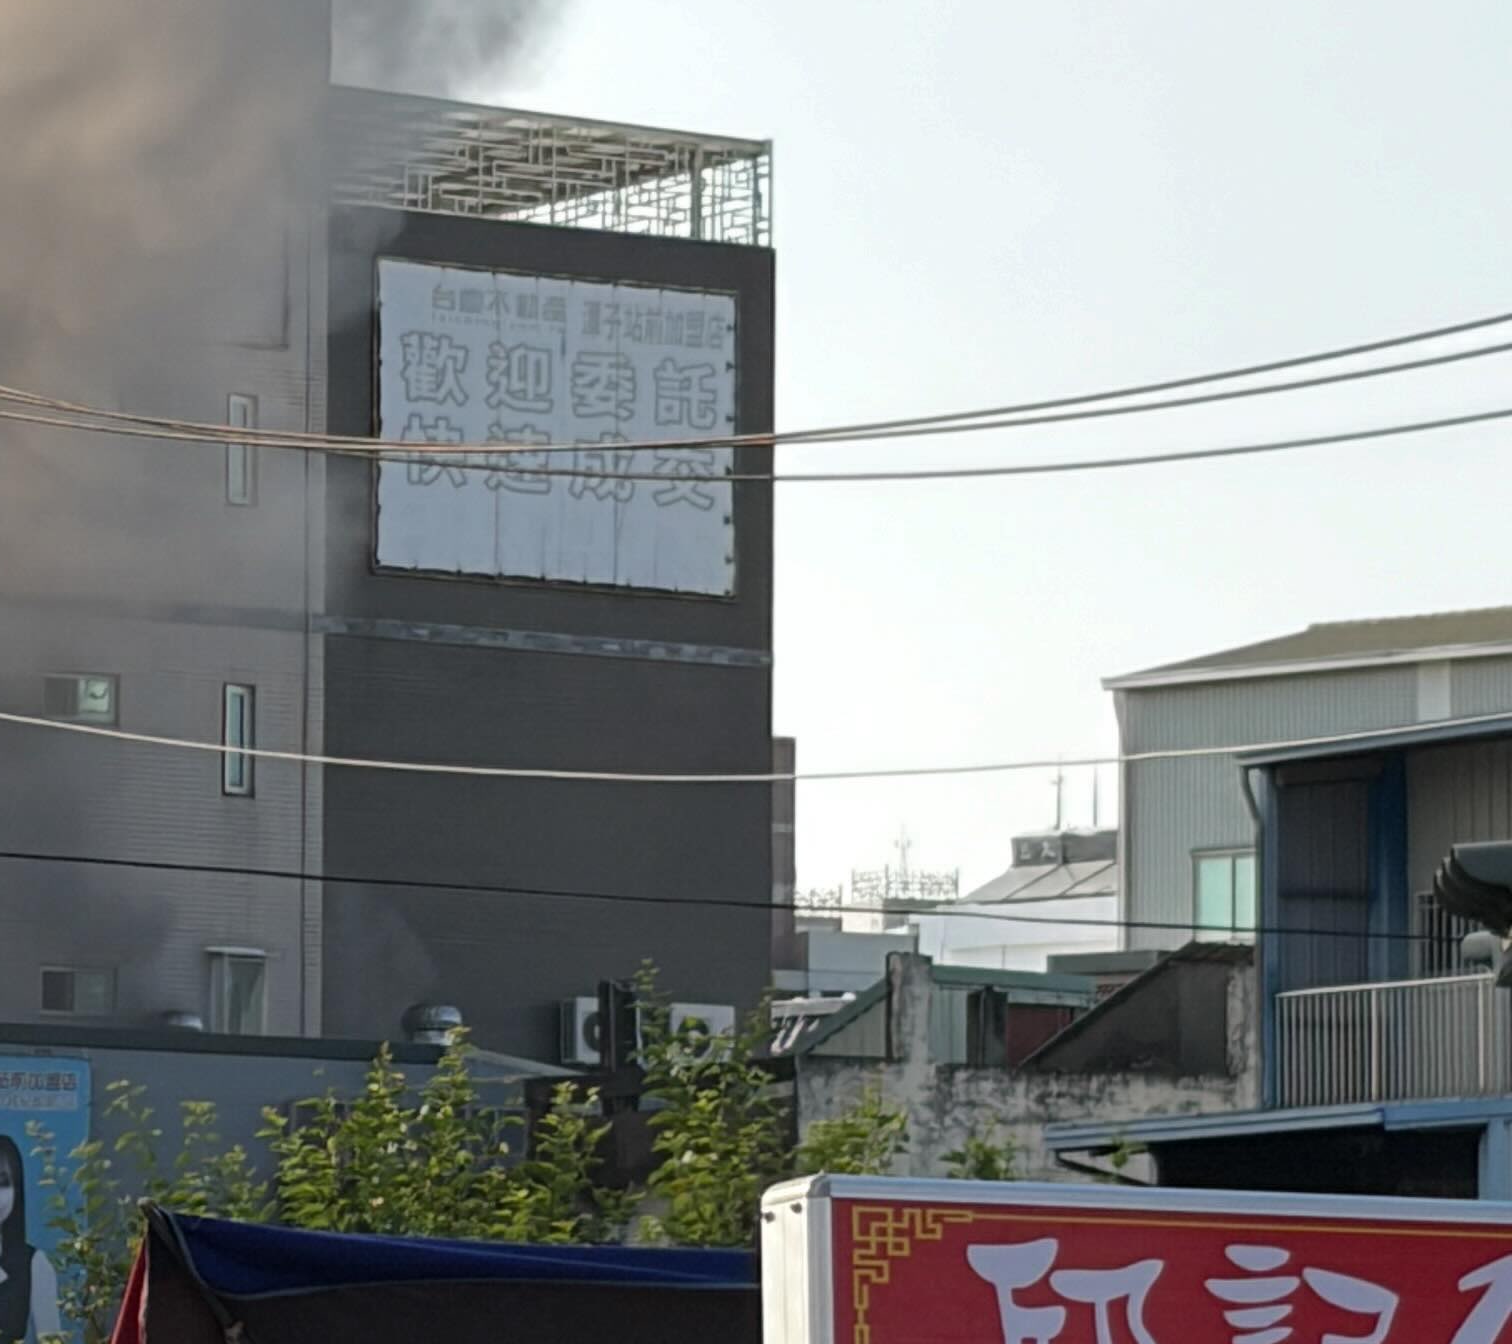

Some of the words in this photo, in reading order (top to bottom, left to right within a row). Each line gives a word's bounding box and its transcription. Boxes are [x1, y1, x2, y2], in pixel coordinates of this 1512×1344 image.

[400, 330, 719, 430] 歡迎委託
[400, 414, 717, 512] 快速成交
